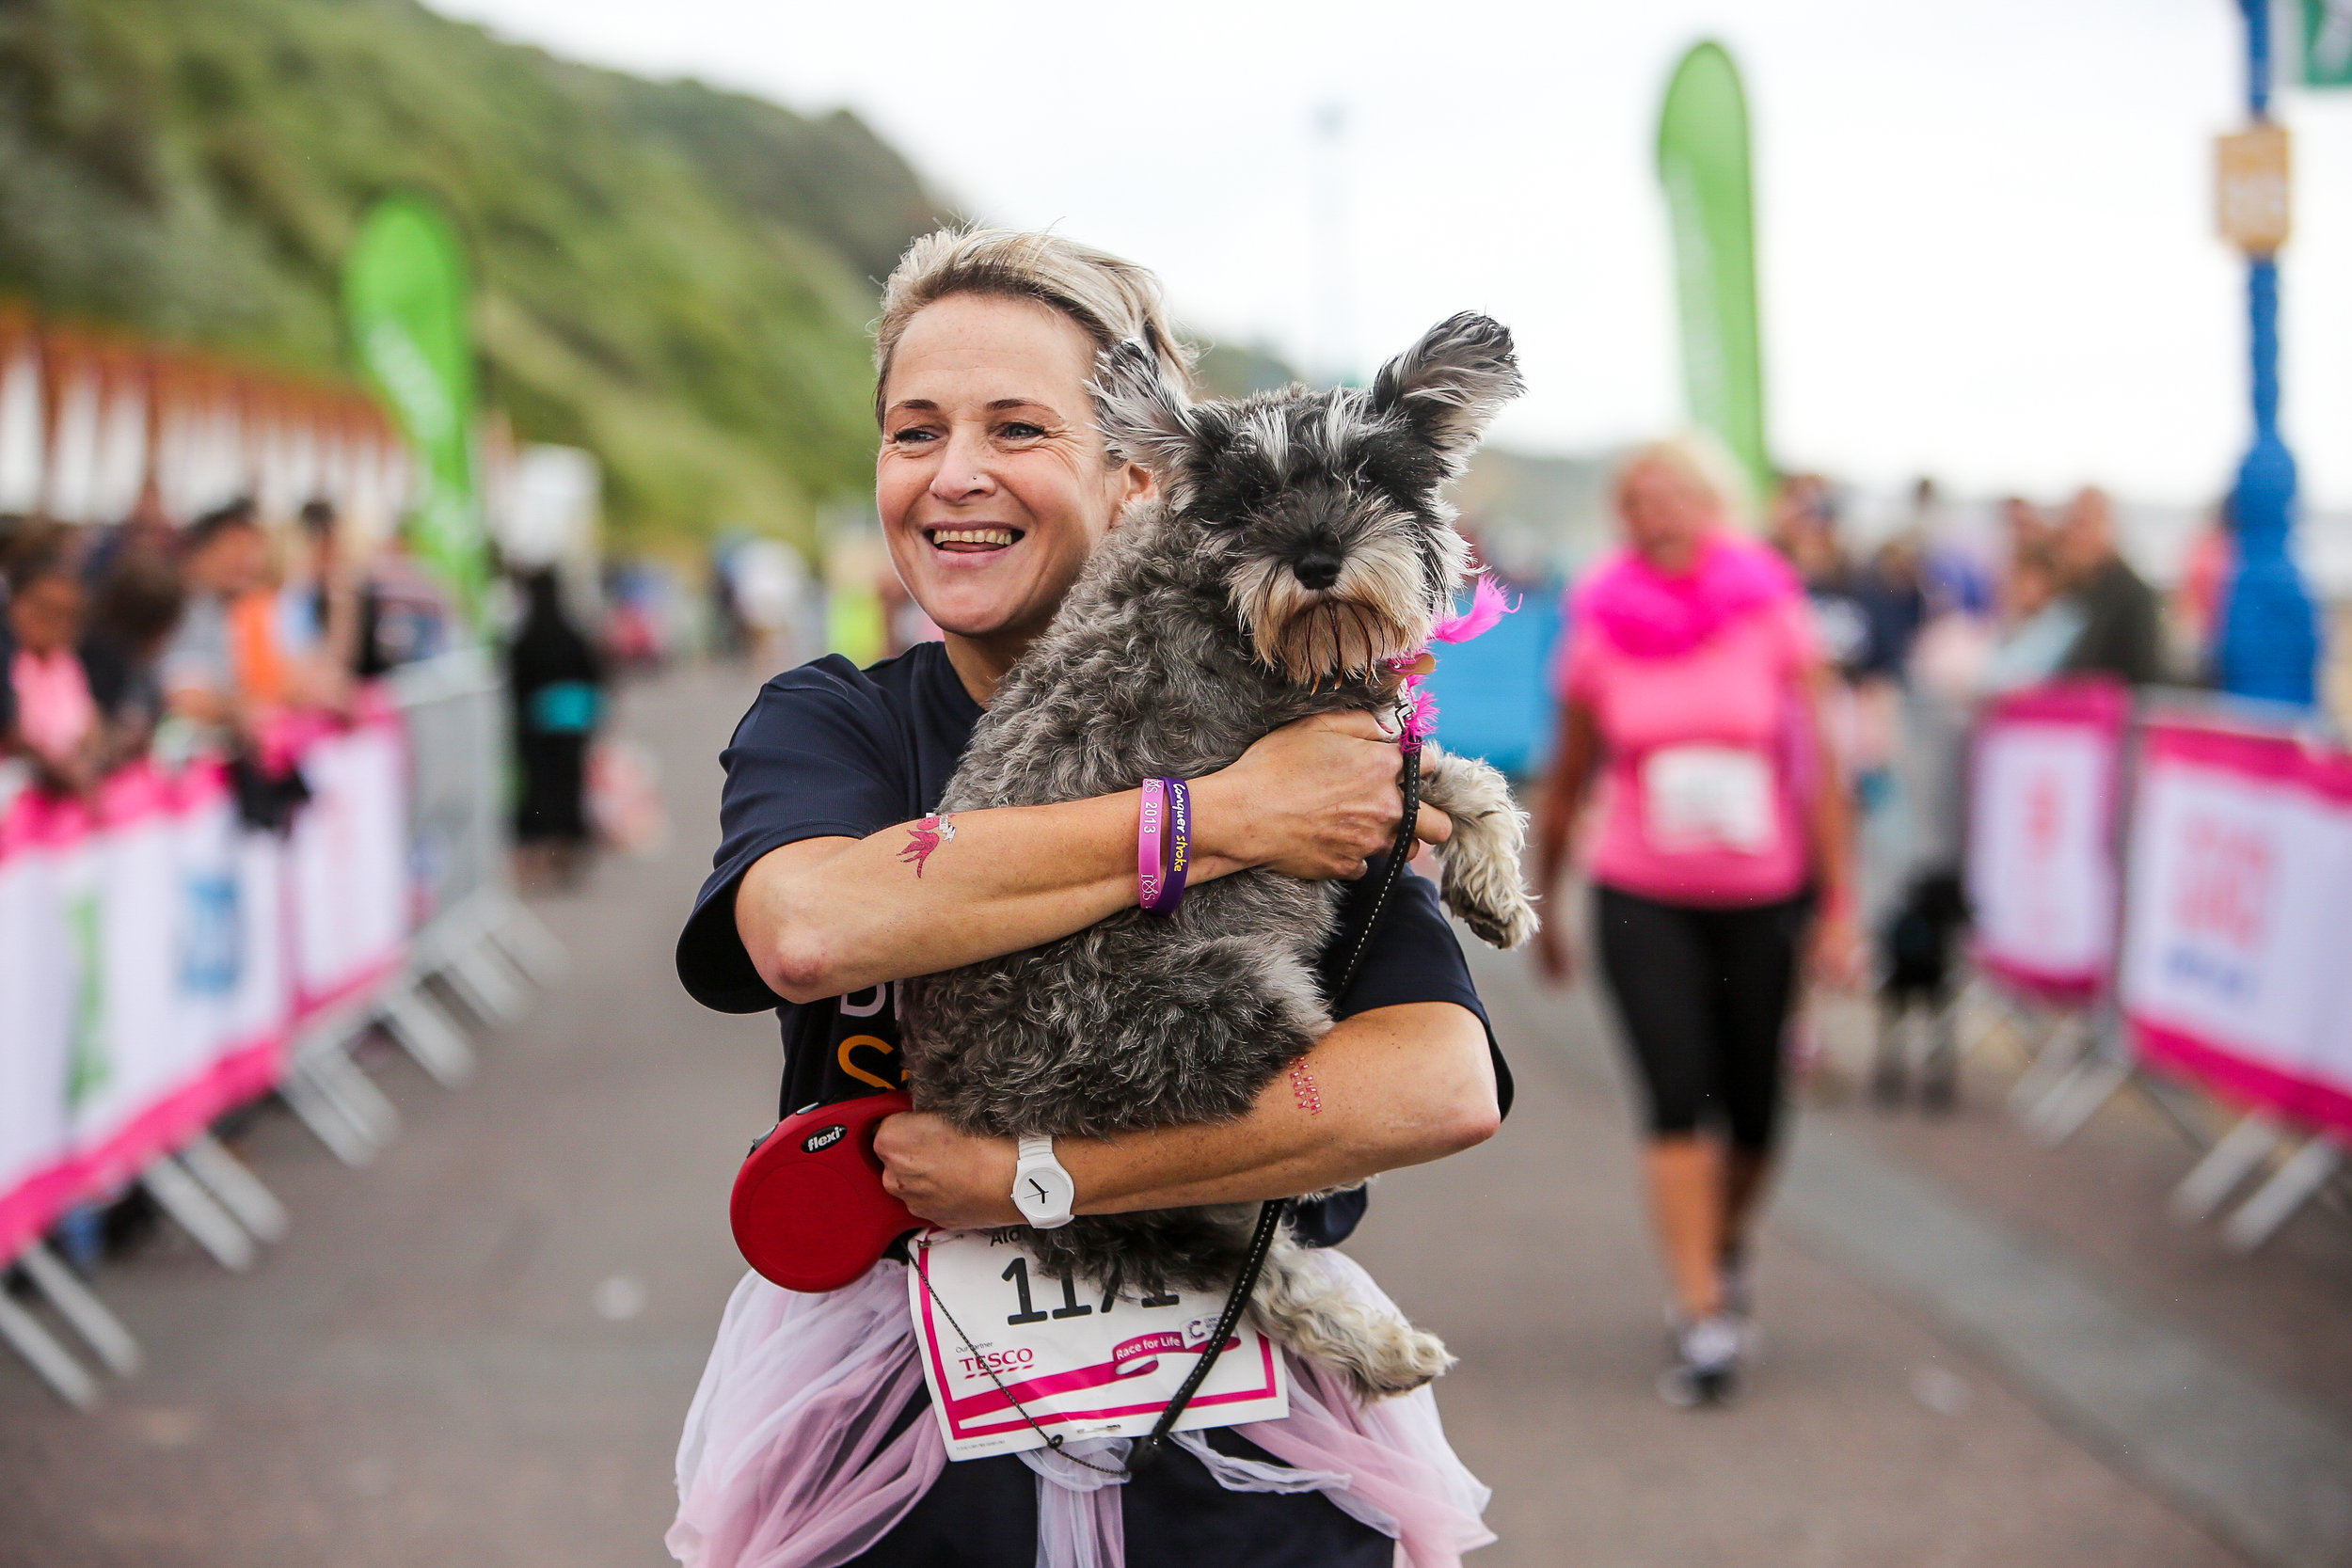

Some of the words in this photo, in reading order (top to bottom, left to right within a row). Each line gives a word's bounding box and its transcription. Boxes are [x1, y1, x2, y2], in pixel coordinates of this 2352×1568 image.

[1143, 801, 1158, 834] 2013
[1171, 783, 1185, 834] Conquer
[1173, 834, 1188, 872] stroke
[807, 1126, 840, 1151] flexi
[970, 1341, 993, 1351] artner
[1116, 1343, 1142, 1360] Race
[1142, 1339, 1159, 1350] for
[1160, 1336, 1181, 1347] Life
[958, 1347, 1033, 1371] TESCO
